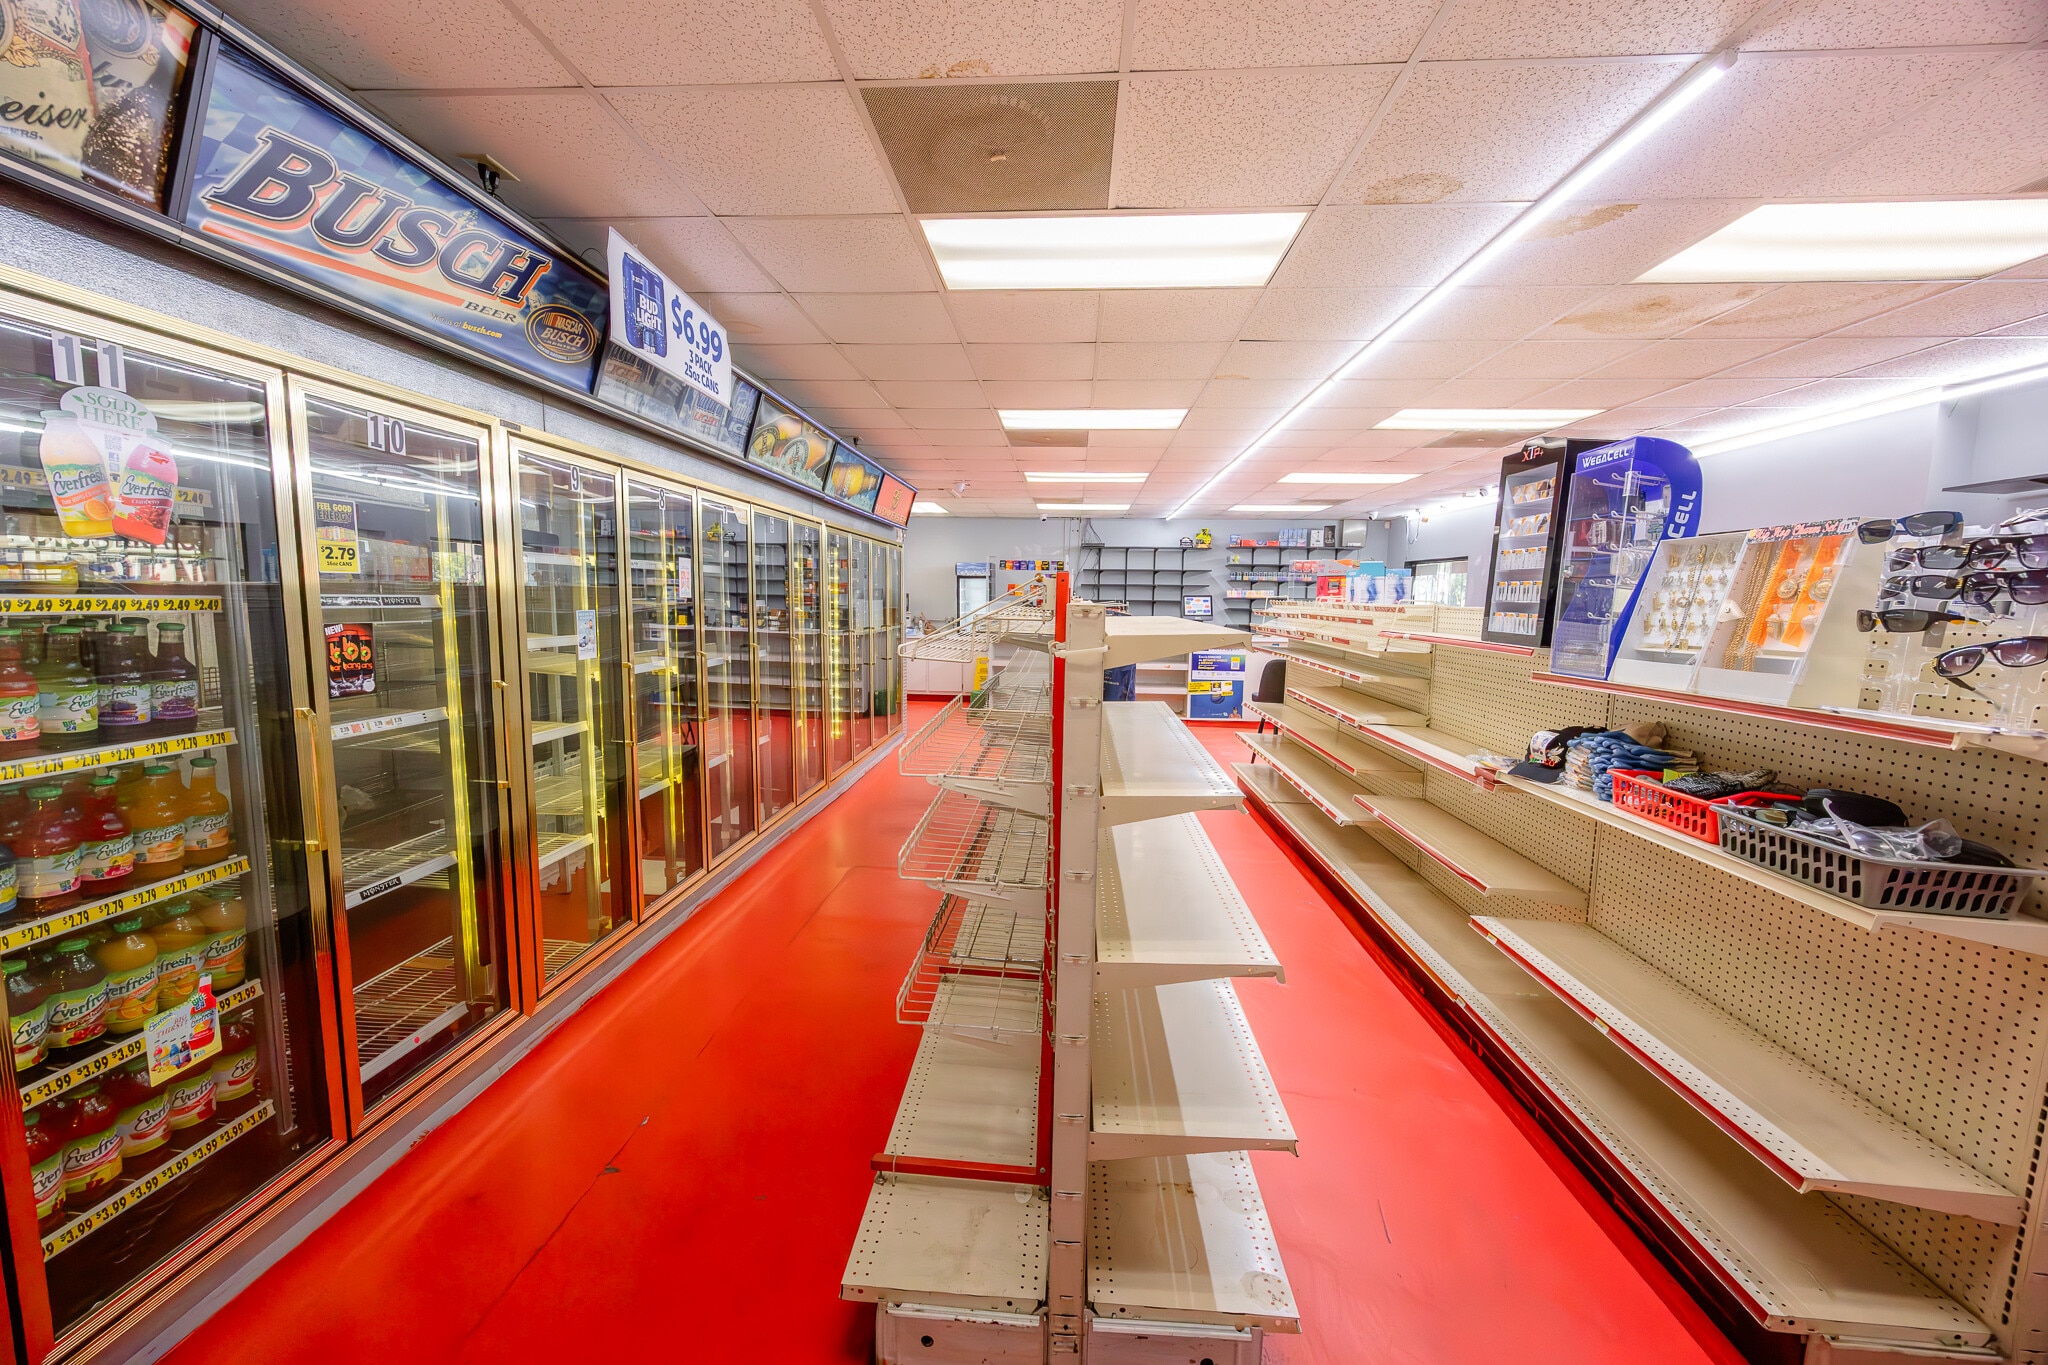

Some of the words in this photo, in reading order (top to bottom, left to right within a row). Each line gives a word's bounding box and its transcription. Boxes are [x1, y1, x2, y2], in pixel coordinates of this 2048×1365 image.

[202, 128, 549, 303] BUSCH
[464, 301, 517, 323] BEER
[639, 293, 659, 315] BUD
[462, 322, 503, 339] busch.com
[556, 317, 583, 335] NASCAR
[636, 308, 663, 332] LIGHT
[671, 294, 723, 363] $6.99
[541, 327, 585, 347] BUSCH
[689, 349, 694, 363] 3
[695, 351, 713, 377] PACK
[701, 372, 719, 395] CANS
[86, 392, 137, 414] SOLD
[82, 404, 145, 431] HERE
[728, 421, 748, 436] ICE
[369, 414, 405, 453] 10
[121, 475, 174, 497] Everfresh
[571, 467, 580, 491] 9
[317, 501, 331, 511] FEEL
[333, 504, 352, 513] GOOD
[659, 489, 665, 509] 8
[317, 510, 352, 523] ENERGY
[1667, 490, 1697, 539] CELL
[321, 546, 355, 560] $2.79
[17, 599, 52, 612] $2.49
[59, 599, 92, 611] $2.49
[96, 599, 126, 611] $2.49
[131, 599, 159, 611] $2.49
[163, 599, 190, 610] $2.49
[194, 599, 219, 610] $2.49
[324, 624, 344, 636] NEW!
[343, 661, 361, 671] bang
[36, 758, 63, 774] $2.79
[111, 747, 135, 761] $2.79
[146, 741, 168, 755] $2.79
[176, 737, 198, 750] $2.79
[205, 732, 226, 745] $2.79
[362, 878, 399, 897] MONSTER
[22, 923, 50, 941] $2.79
[62, 910, 89, 928] $2.79
[98, 899, 124, 915] $2.79
[133, 889, 157, 905] $2.79
[165, 879, 188, 894] $2.79
[196, 869, 217, 884] $2.79
[223, 860, 243, 875] $2.79
[37, 1075, 72, 1097] $3.99
[77, 1056, 109, 1078] $3.99
[112, 1040, 141, 1061] $3.99
[233, 986, 256, 1003] $3.99
[60, 1219, 93, 1243] $3.99
[96, 1197, 127, 1220] $3.99
[130, 1176, 159, 1199] $3.99
[162, 1158, 189, 1179] $3.99
[192, 1139, 218, 1159] $3.99
[220, 1122, 244, 1141] $3.99
[246, 1106, 268, 1125] $3.99
